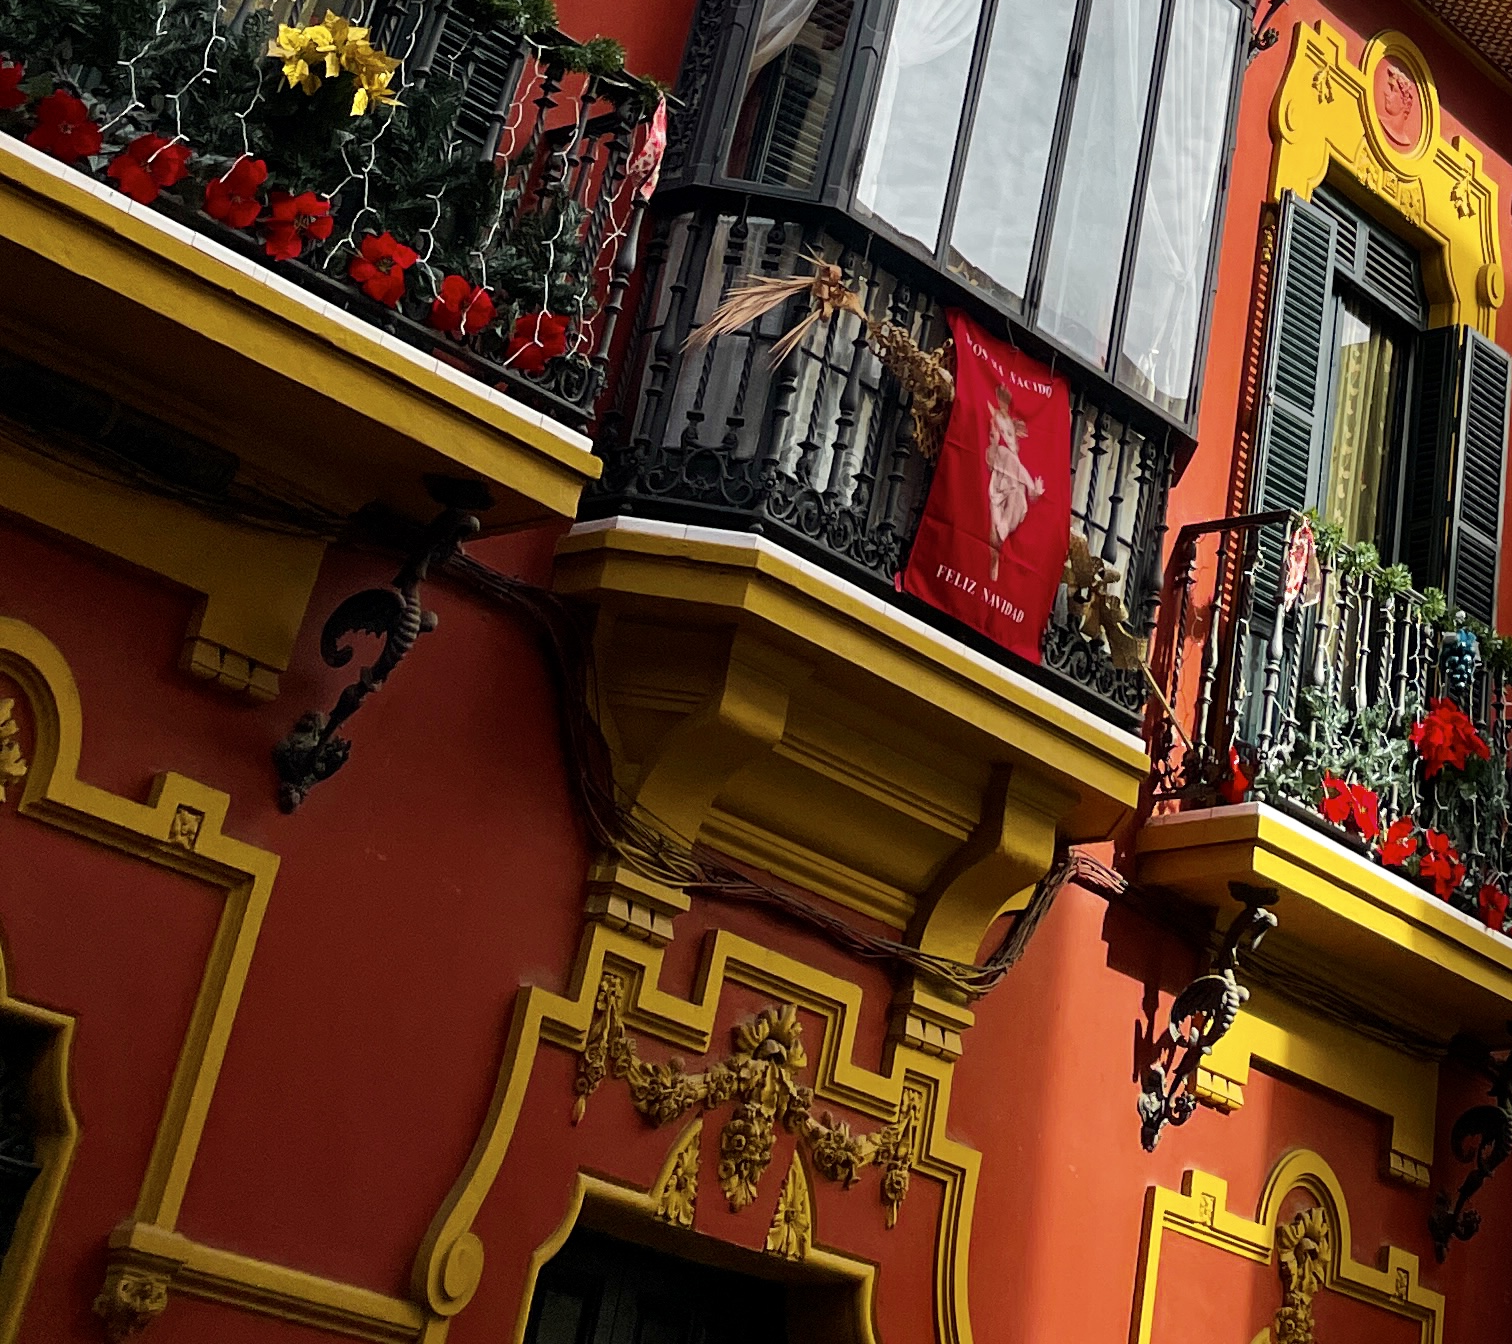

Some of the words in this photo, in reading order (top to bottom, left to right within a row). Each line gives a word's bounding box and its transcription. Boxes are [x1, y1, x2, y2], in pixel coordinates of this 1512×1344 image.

[1010, 371, 1053, 399] NACIDO
[936, 564, 977, 595] FELIZ
[981, 587, 1025, 623] NAVIDAD
